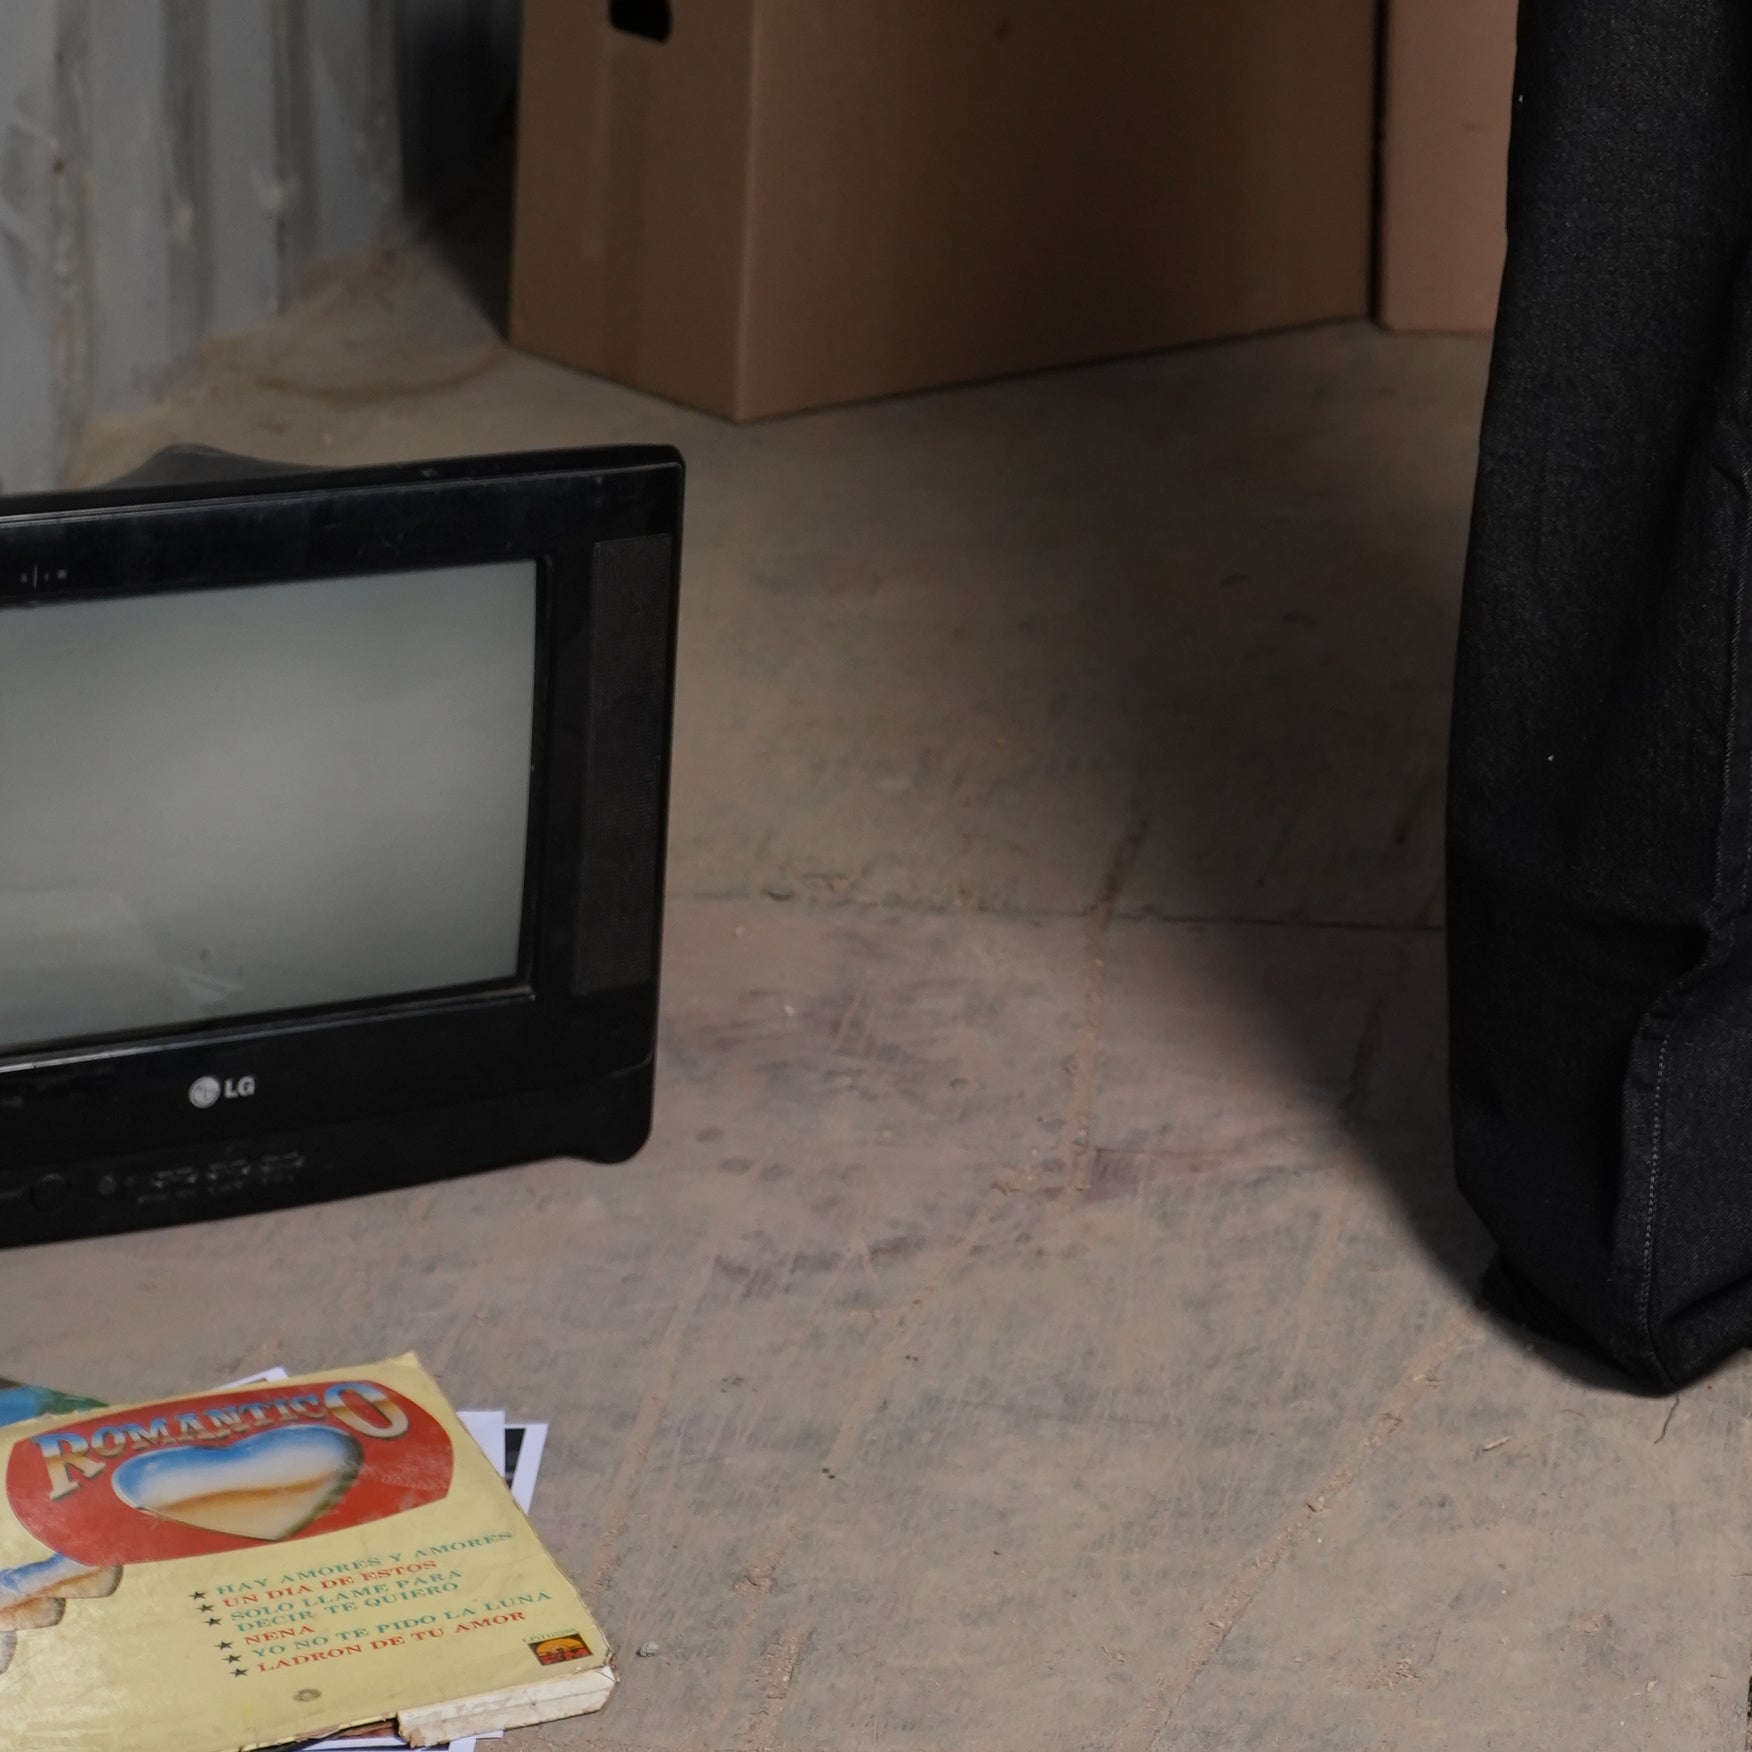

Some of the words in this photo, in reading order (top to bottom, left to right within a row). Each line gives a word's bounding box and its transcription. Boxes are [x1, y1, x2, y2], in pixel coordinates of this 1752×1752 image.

[224, 1076, 256, 1098] LG
[31, 1381, 410, 1501] ROMANTICO
[217, 1578, 268, 1595] HAY
[280, 1557, 382, 1584] AMORES
[388, 1552, 402, 1563] Y
[414, 1530, 513, 1558] AMORES
[223, 1594, 258, 1608] UN
[266, 1584, 313, 1600] DIA
[320, 1576, 355, 1589] DE
[361, 1560, 438, 1582] ESTOS
[230, 1602, 295, 1622] SOLO
[302, 1583, 389, 1608] LLAME
[396, 1570, 463, 1589] PARA
[236, 1610, 315, 1633] DECIR
[323, 1601, 359, 1615] TE
[363, 1582, 460, 1609] QUIERO
[244, 1625, 316, 1646] NENA
[251, 1645, 286, 1658] YO
[294, 1636, 330, 1651] NO
[335, 1627, 370, 1642] TE
[376, 1615, 437, 1635] PIDO
[445, 1607, 477, 1621] LA
[485, 1591, 553, 1613] LUNA
[257, 1644, 364, 1673] LADRON
[369, 1635, 406, 1651] DE
[410, 1627, 446, 1643] TU
[454, 1611, 527, 1635] AMOR
